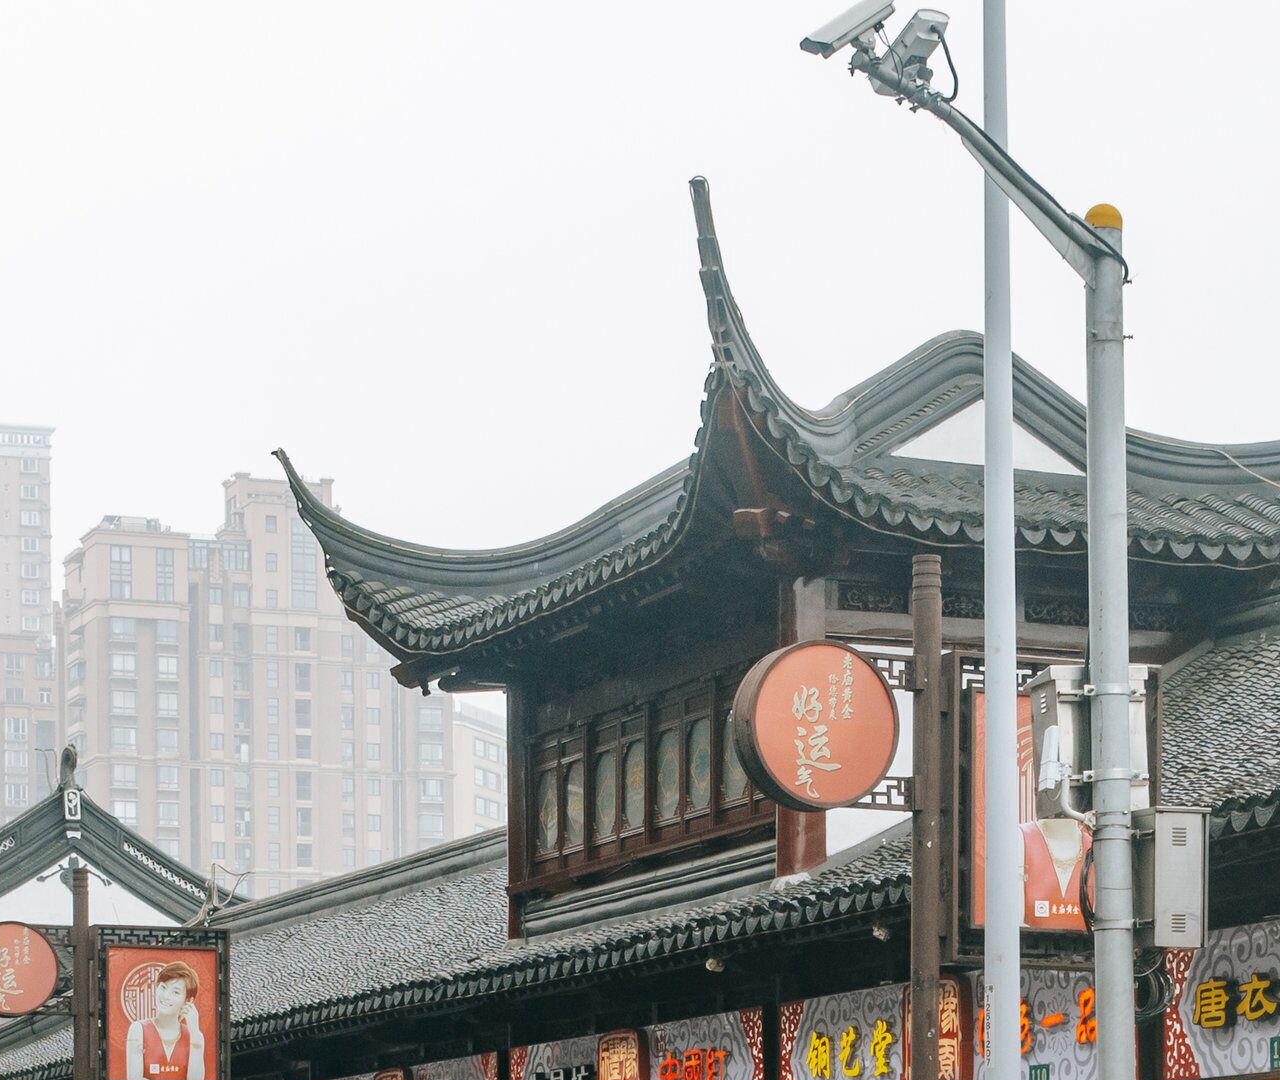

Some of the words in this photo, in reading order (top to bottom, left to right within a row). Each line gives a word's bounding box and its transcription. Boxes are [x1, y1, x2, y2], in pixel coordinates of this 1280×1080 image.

[791, 684, 842, 799] 好运气
[806, 1019, 893, 1080] 铜艺堂
